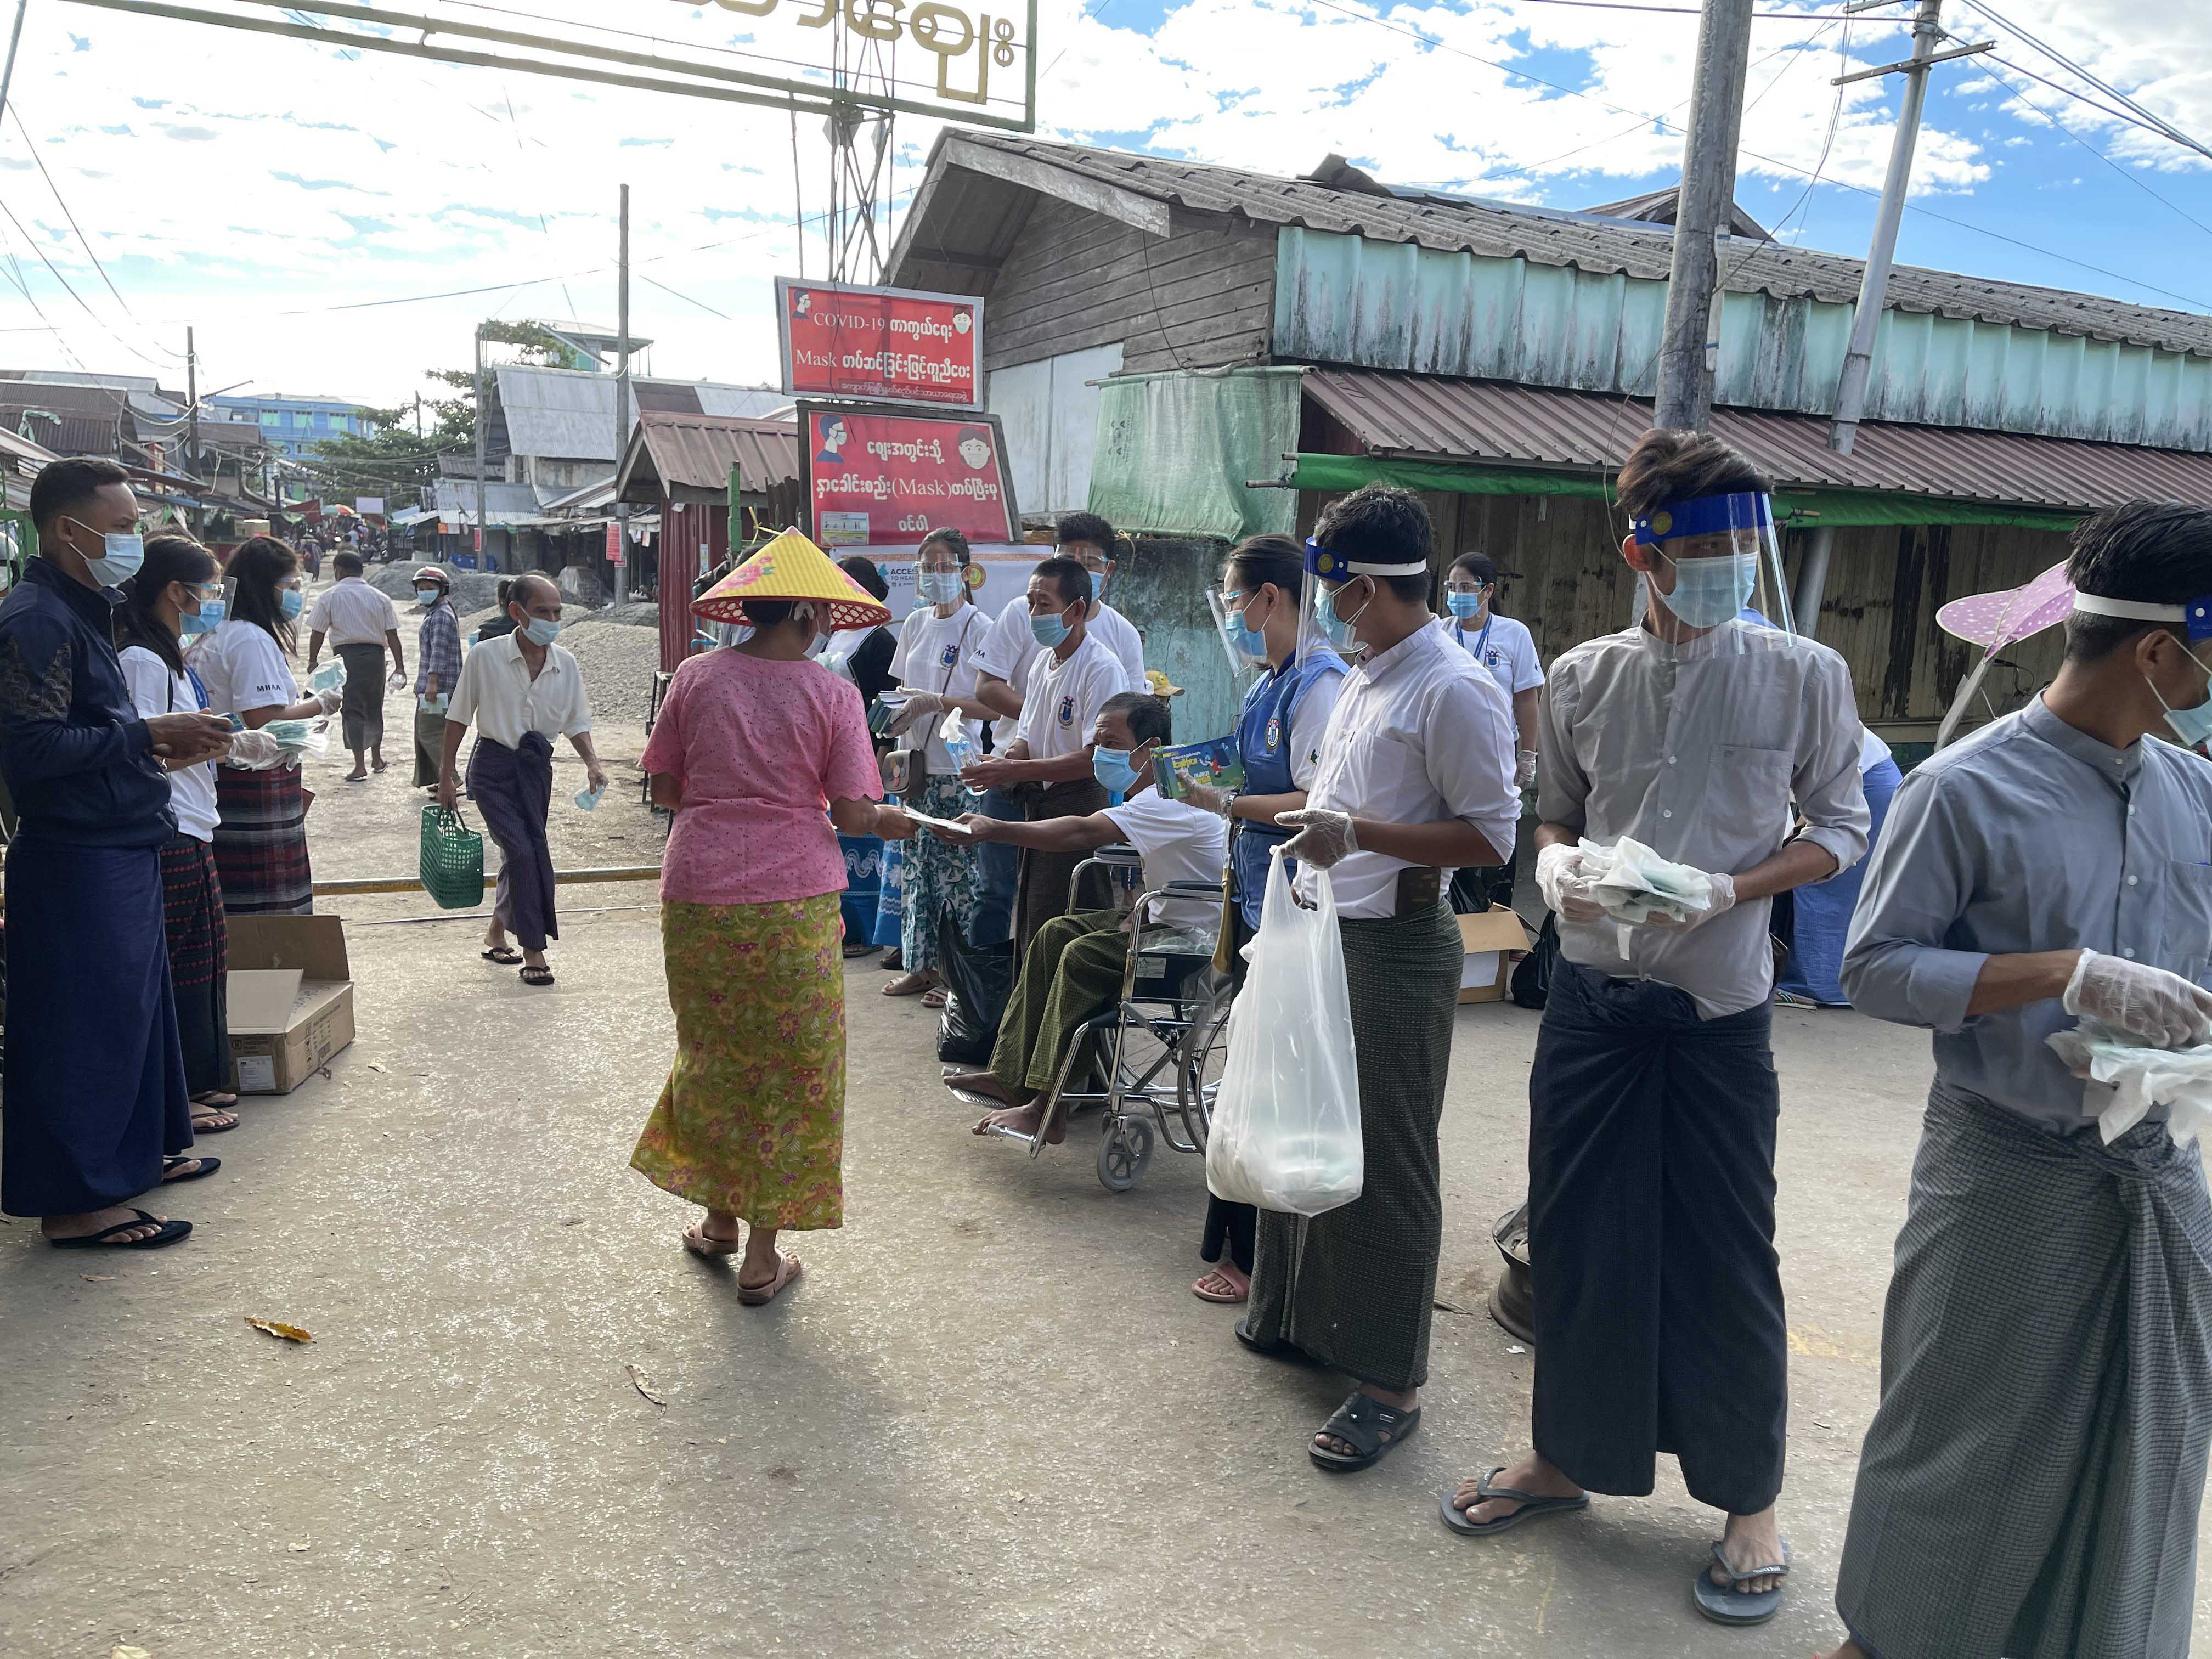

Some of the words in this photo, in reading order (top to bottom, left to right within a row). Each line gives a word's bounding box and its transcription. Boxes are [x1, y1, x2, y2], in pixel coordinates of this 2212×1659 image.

[814, 312, 885, 331] COVID-19
[890, 316, 953, 344] ကာကွယ်ရေး
[796, 349, 838, 368] Mask
[898, 514, 929, 532] ဝင်ပါ
